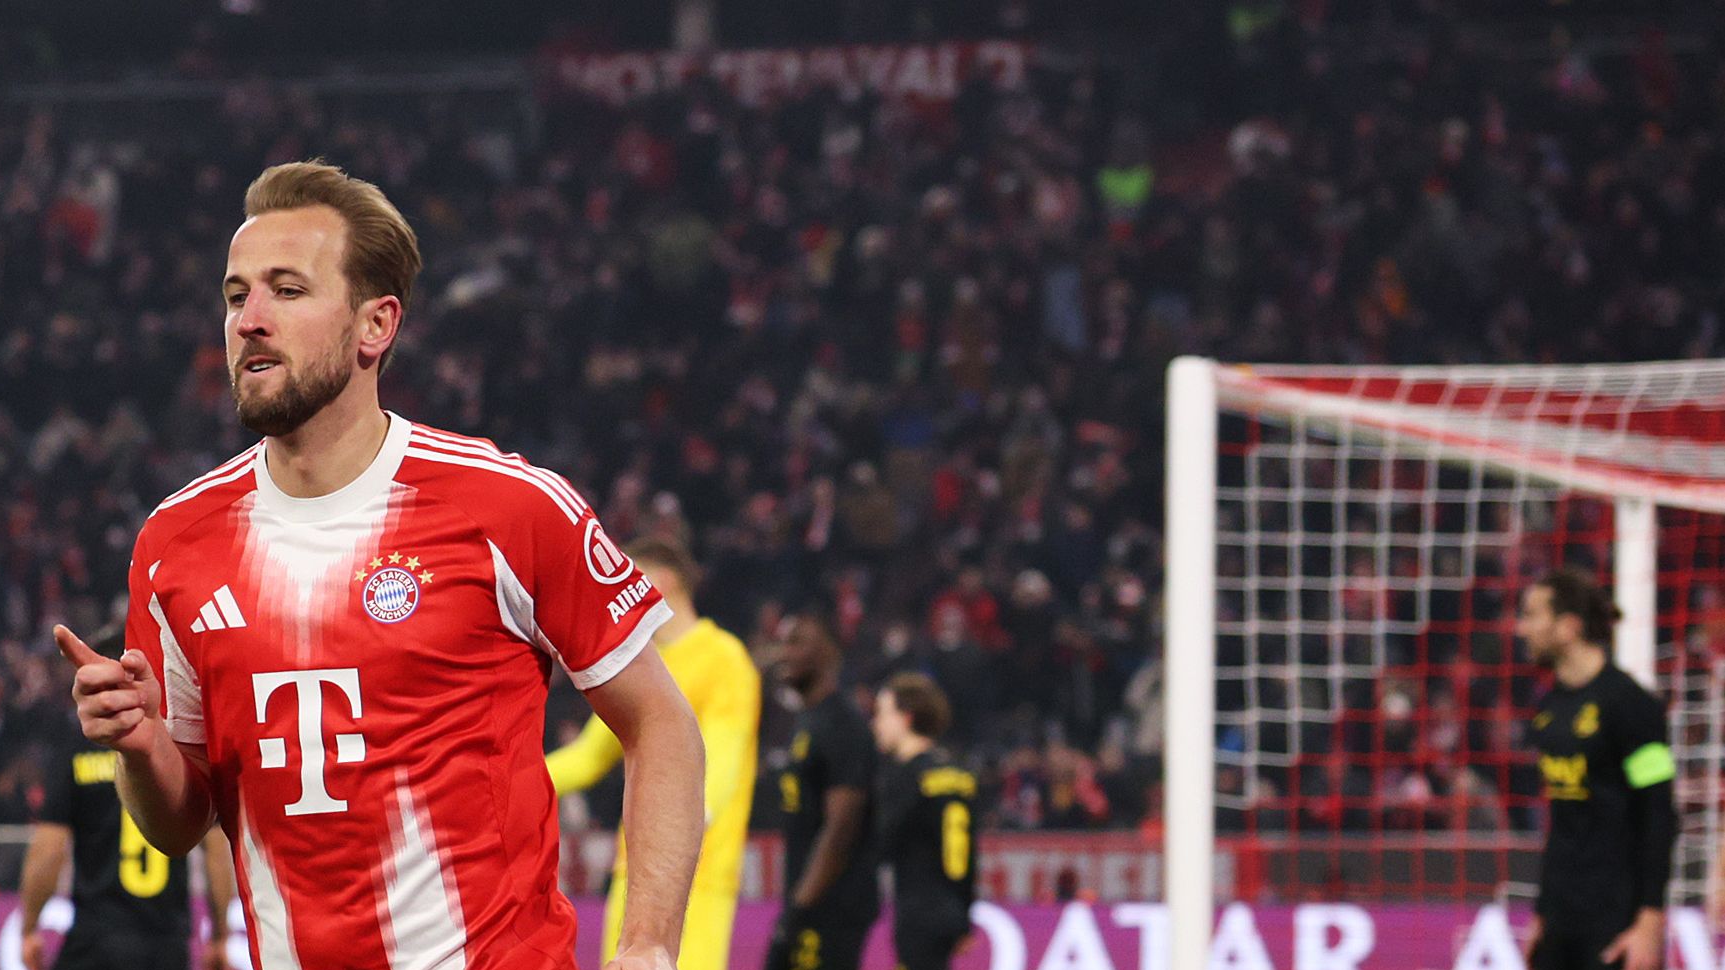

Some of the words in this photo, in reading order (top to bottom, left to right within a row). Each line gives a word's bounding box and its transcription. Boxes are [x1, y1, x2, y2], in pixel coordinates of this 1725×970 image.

[368, 578, 381, 592] FC
[380, 571, 415, 593] BAYERN
[366, 599, 413, 620] MÜNCHEN
[252, 668, 365, 817] T
